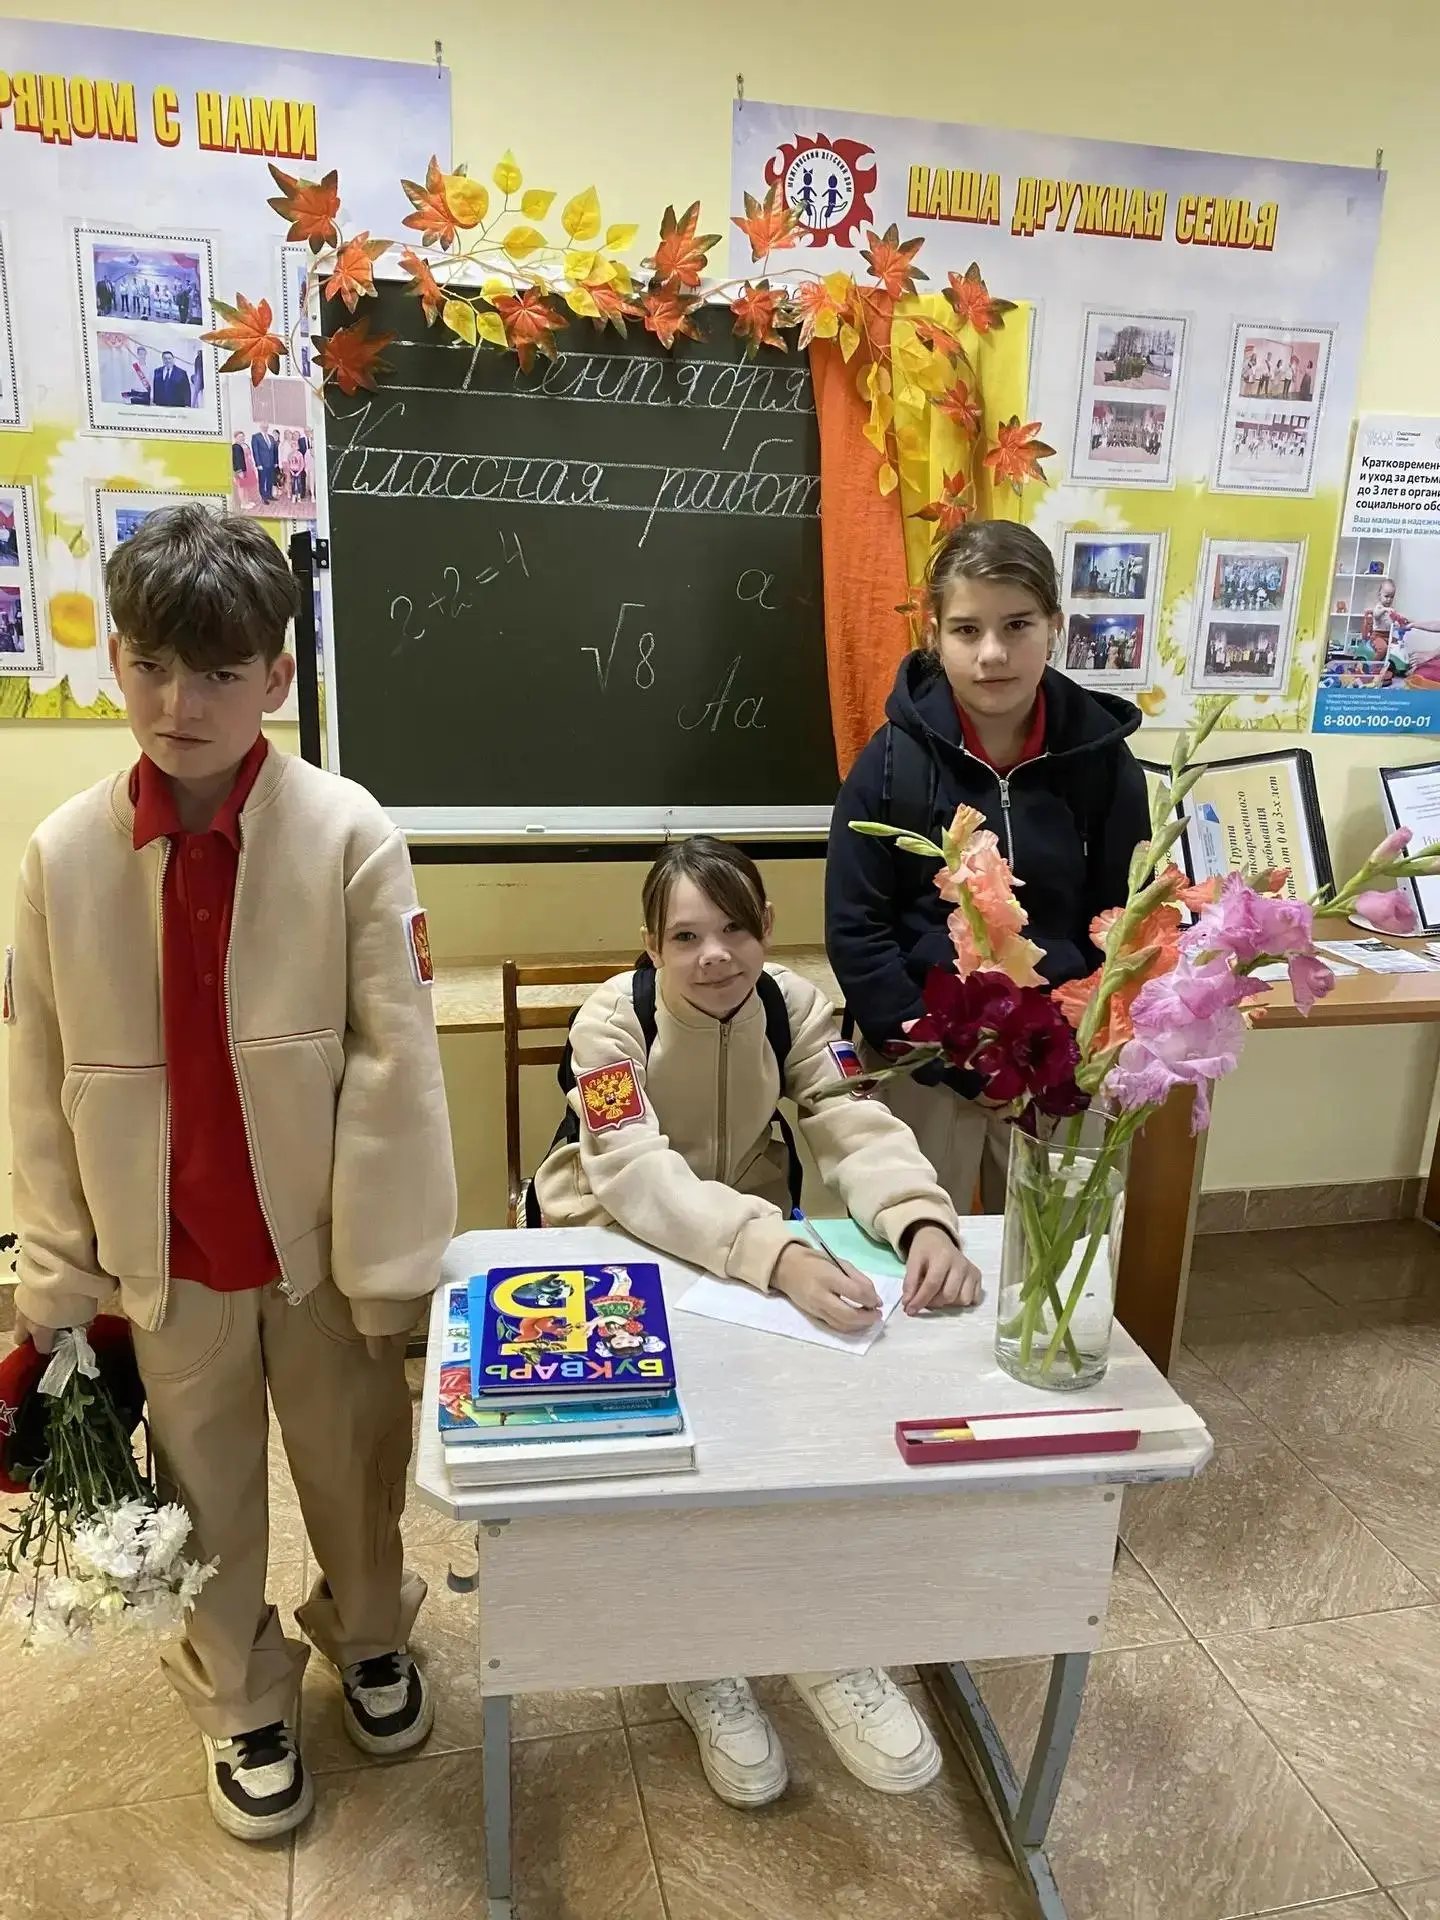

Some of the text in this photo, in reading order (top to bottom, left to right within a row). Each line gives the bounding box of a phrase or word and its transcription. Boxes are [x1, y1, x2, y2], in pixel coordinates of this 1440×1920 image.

[152, 84, 181, 148] С
[196, 90, 318, 161] НАМИ
[907, 165, 1280, 251] НАША ДРУЖНАЯ СЕМЬЯ
[1360, 473, 1367, 481] и
[1368, 473, 1393, 484] уход
[1394, 474, 1406, 483] за
[1357, 486, 1371, 496] до
[1372, 485, 1380, 496] 3
[1380, 487, 1399, 497] лет
[1400, 488, 1407, 497] в
[1355, 500, 1422, 511] социального
[1323, 714, 1431, 728] 8-800-100-00-01
[1275, 821, 1286, 834] до
[1228, 825, 1242, 865] Группа
[1281, 847, 1291, 864] от
[485, 1357, 665, 1381] БУКВАРЬ
